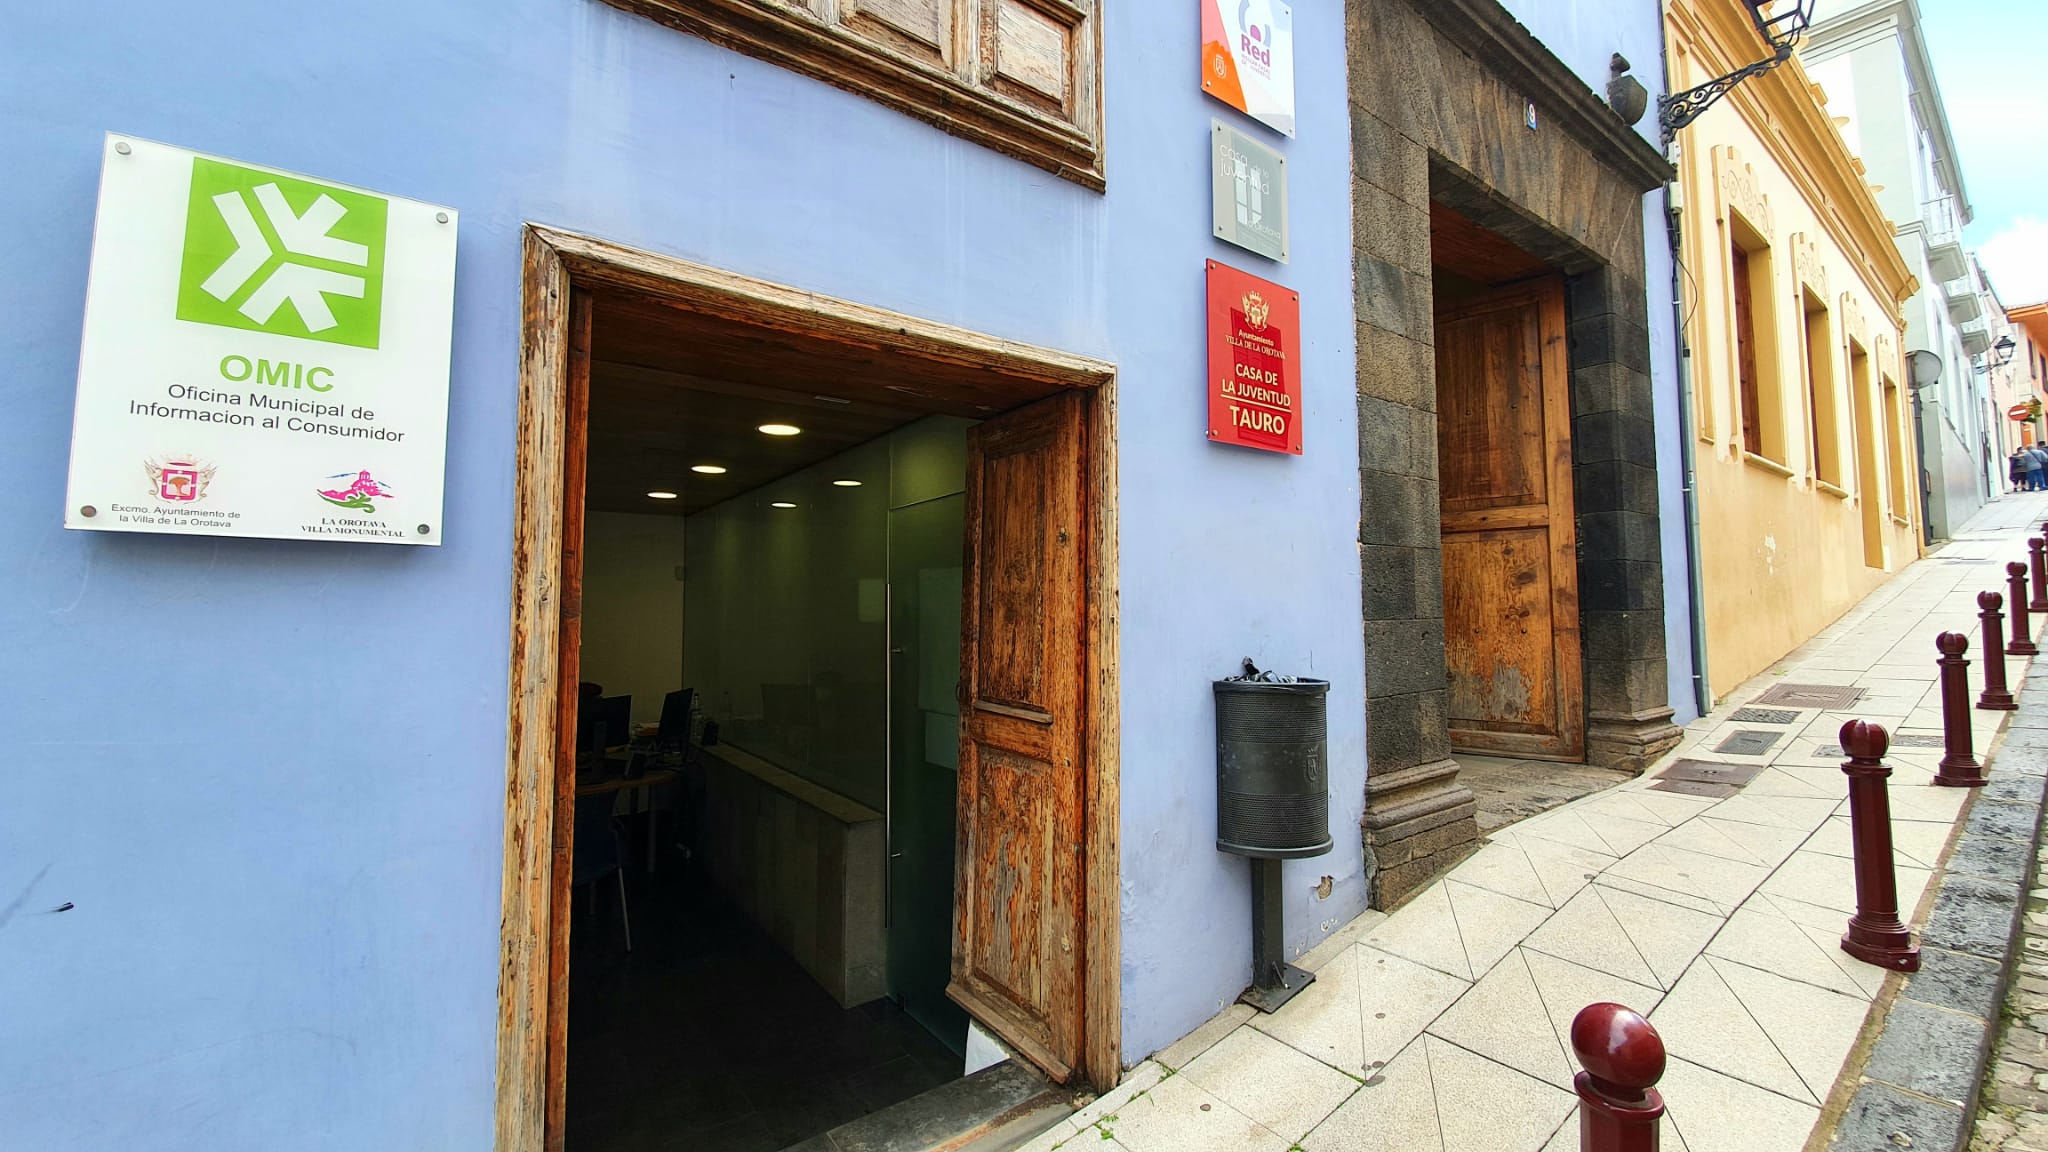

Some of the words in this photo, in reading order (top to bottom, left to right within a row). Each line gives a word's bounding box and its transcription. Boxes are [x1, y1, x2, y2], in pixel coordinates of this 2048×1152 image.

[1241, 33, 1270, 67] Red
[1225, 334, 1243, 347] VILLA
[1244, 340, 1252, 349] DE
[1253, 343, 1260, 353] LA
[1261, 345, 1286, 359] OROTAVA
[1238, 329, 1274, 346] Ayuntamiento
[219, 355, 335, 392] OMIC
[1236, 363, 1263, 382] CASA
[1265, 371, 1278, 385] DE
[168, 384, 241, 405] Oficina
[249, 393, 344, 419] Municipal
[351, 406, 375, 421] de
[1222, 378, 1236, 394] LA
[1238, 383, 1291, 406] JUVENTUD
[130, 400, 254, 427] Informacion
[262, 415, 280, 430] al
[287, 418, 405, 443] Consumidor
[1229, 405, 1285, 435] TAURO
[111, 504, 151, 513] Excmo.
[154, 506, 225, 518] Ayuntamiento
[228, 511, 241, 519] de
[119, 514, 129, 522] la
[132, 516, 155, 524] Villa
[158, 517, 171, 525] de
[174, 518, 187, 526] La
[190, 519, 232, 528] Orotava
[322, 517, 336, 526] LA
[338, 518, 387, 529] OROTAVA
[301, 525, 332, 534] VILLA
[334, 527, 406, 538] MONUMENTAL
